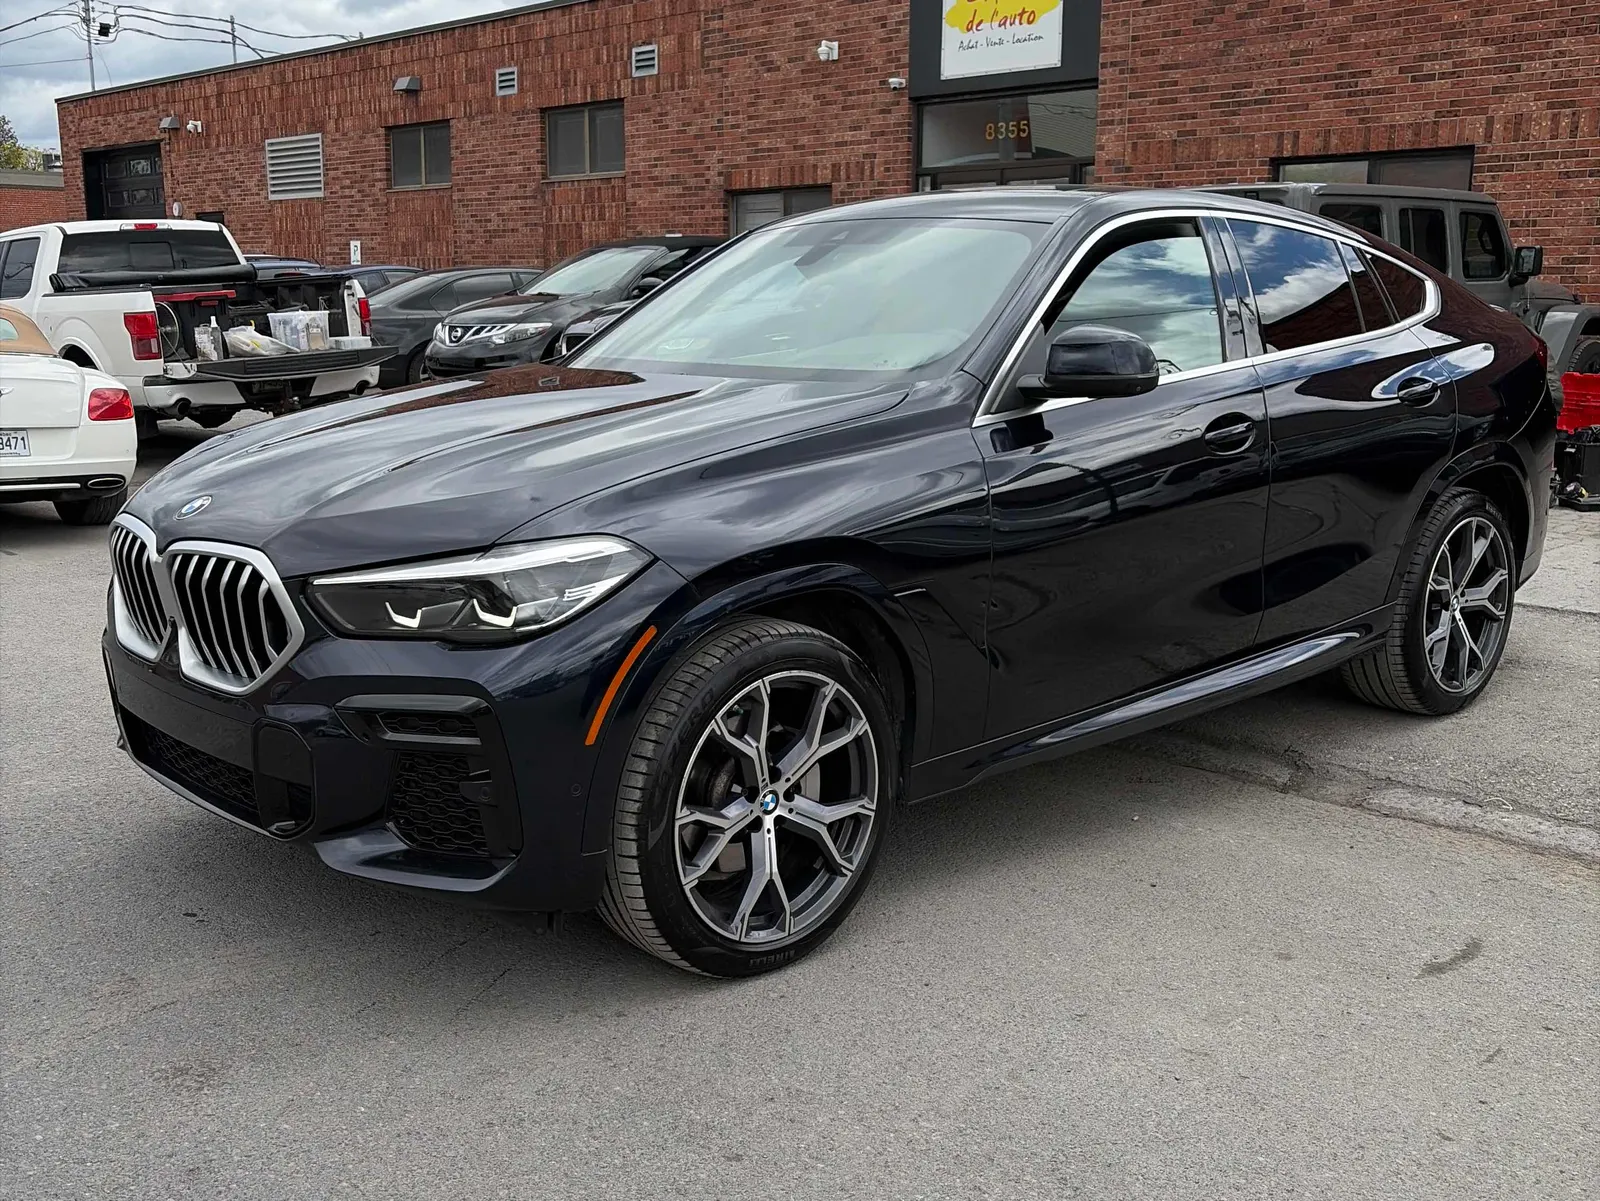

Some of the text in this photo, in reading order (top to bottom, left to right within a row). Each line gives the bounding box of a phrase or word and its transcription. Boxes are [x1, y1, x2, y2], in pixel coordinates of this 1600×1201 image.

[966, 7, 1036, 34] de l'auto
[958, 38, 978, 52] Achat
[985, 36, 1005, 49] Vente
[1012, 33, 1044, 45] Location
[985, 121, 1029, 140] 8355
